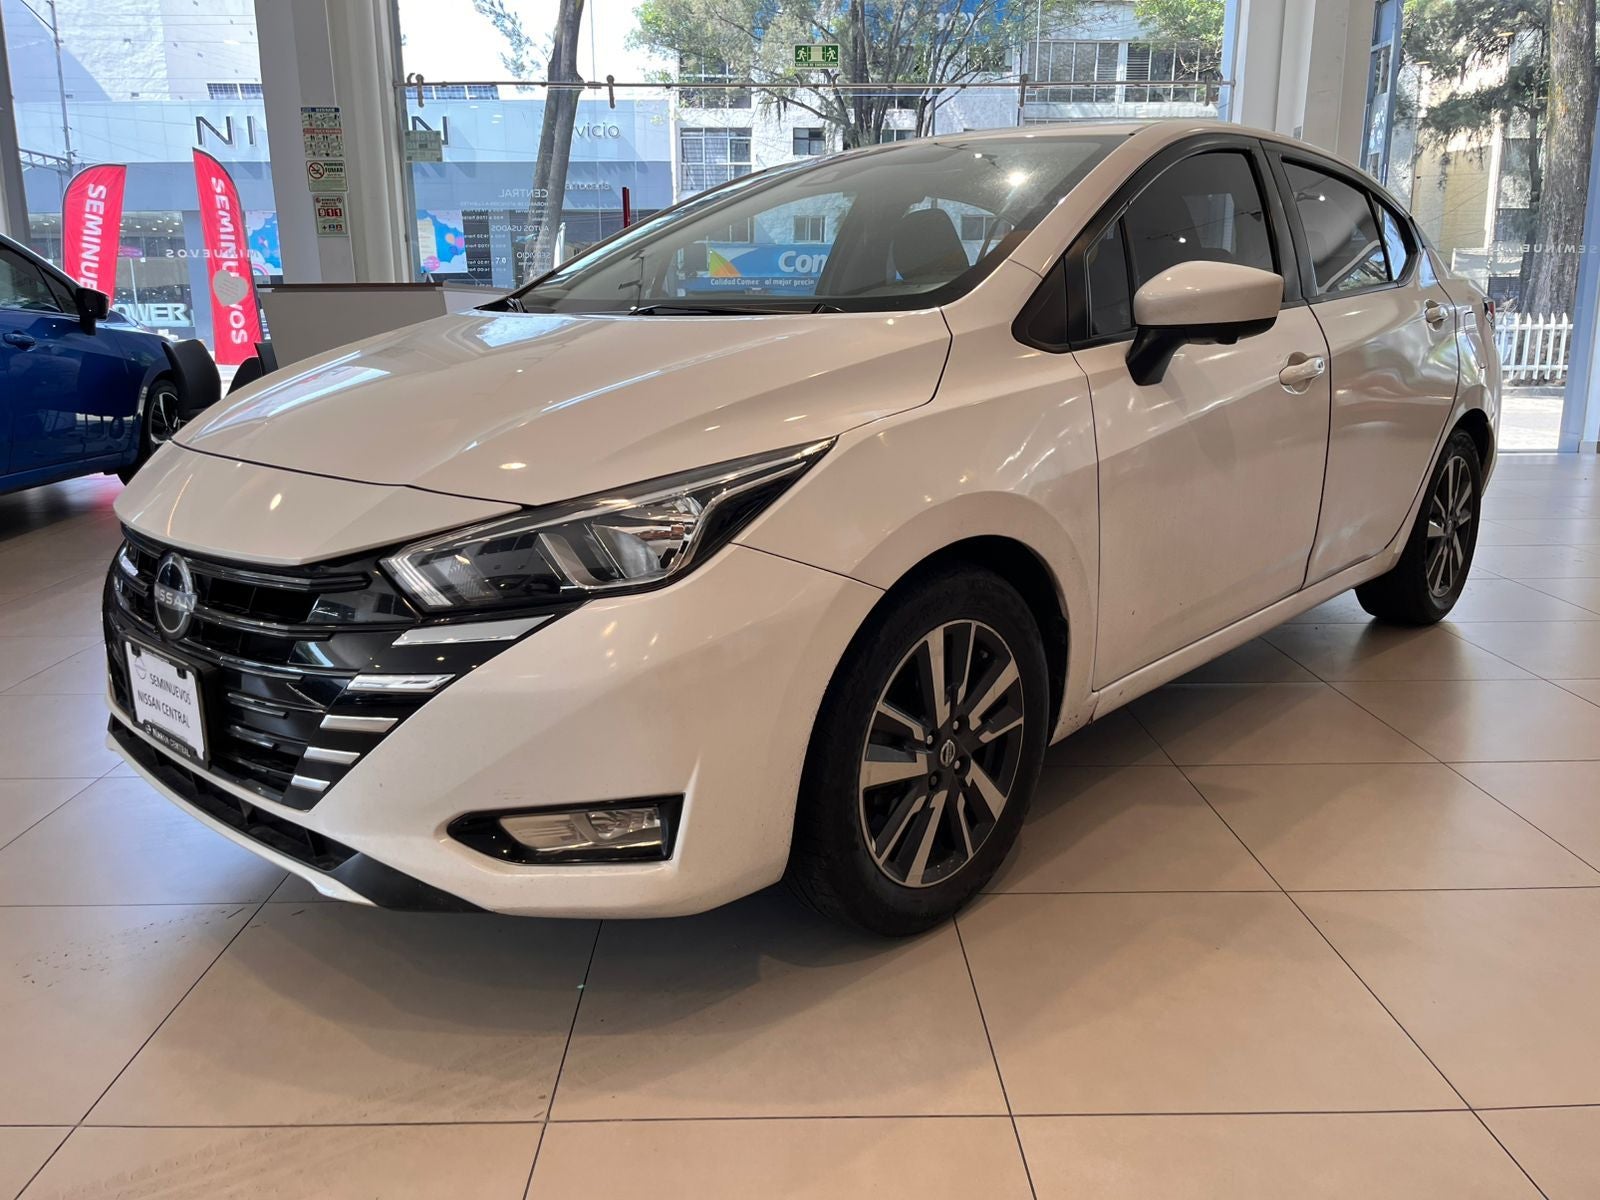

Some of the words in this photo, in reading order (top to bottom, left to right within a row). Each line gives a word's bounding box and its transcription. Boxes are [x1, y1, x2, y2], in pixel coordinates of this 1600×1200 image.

[575, 122, 620, 138] vicio
[318, 208, 342, 217] 911
[79, 183, 107, 291] SEMINUE
[211, 177, 248, 344] SEMINUOS
[710, 278, 736, 286] Calidad
[773, 278, 792, 287] mejor
[111, 303, 190, 327] OWER
[149, 673, 192, 706] SEMINUEVOS
[137, 689, 161, 711] NISSAN
[161, 702, 190, 729] CENTRAL
